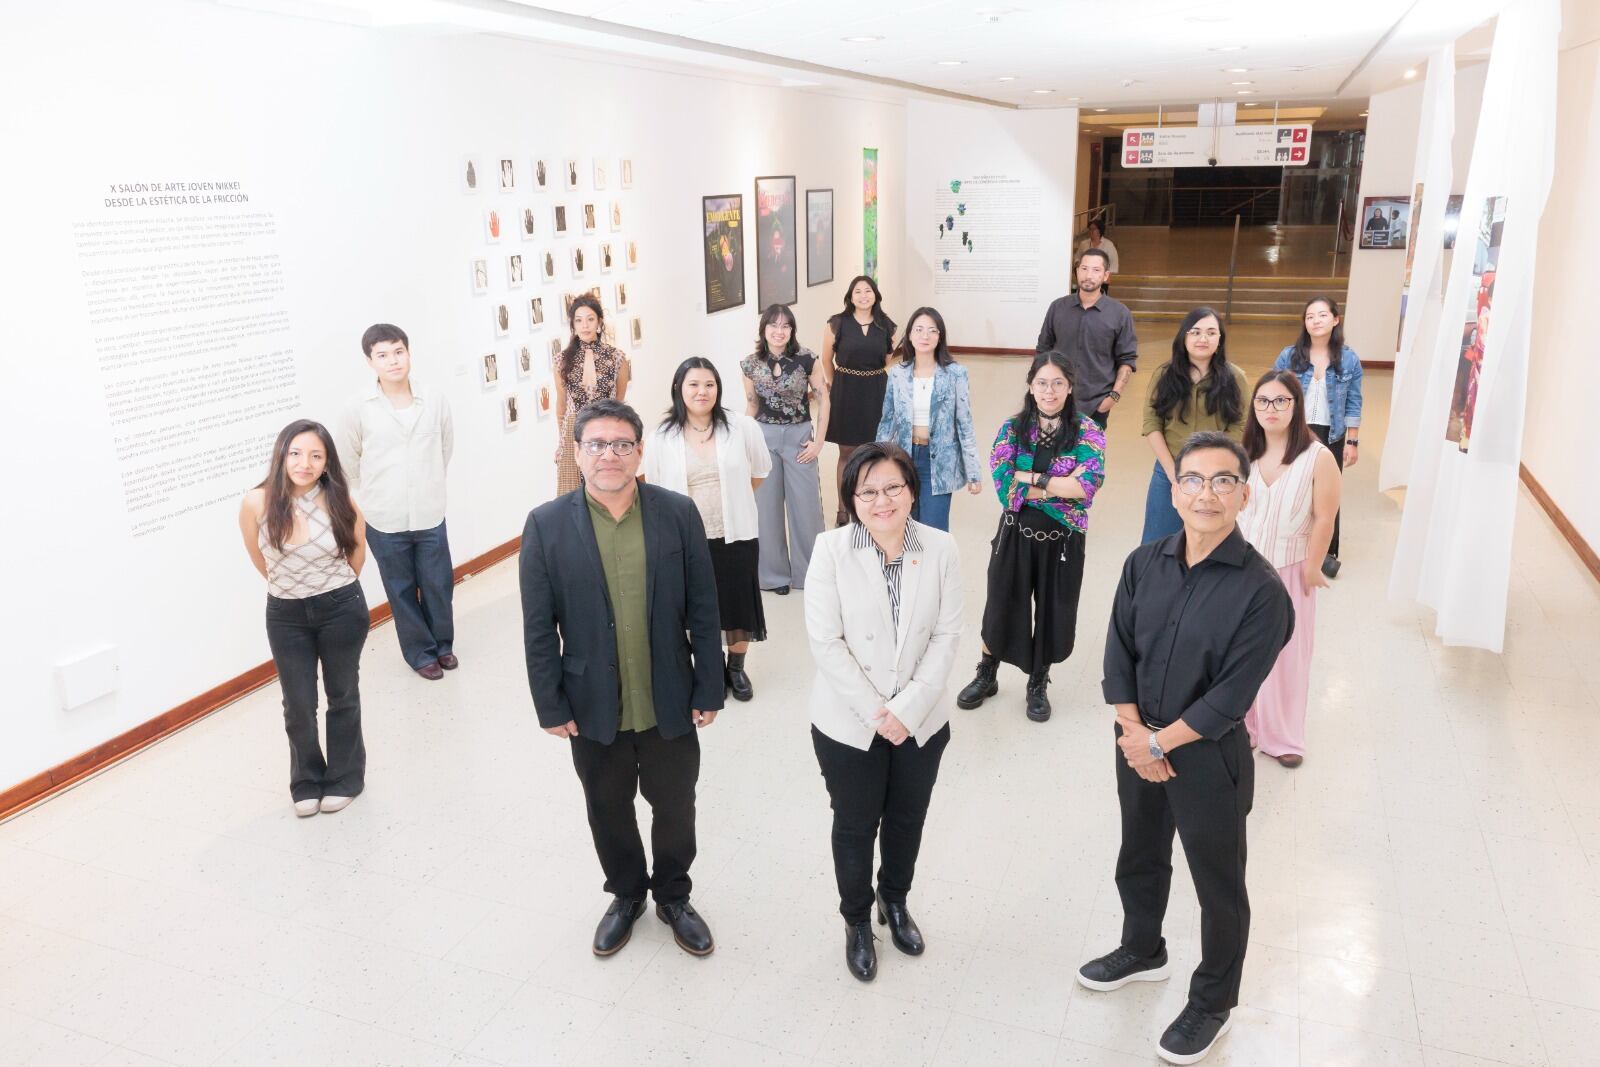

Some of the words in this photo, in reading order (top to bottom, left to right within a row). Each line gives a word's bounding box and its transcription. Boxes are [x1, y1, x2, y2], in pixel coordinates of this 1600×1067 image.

[118, 182, 148, 193] SALÓN
[151, 183, 163, 192] DE
[165, 183, 186, 192] ARTE
[188, 182, 214, 192] JOVEN
[216, 182, 240, 191] NIKKEI
[105, 197, 134, 208] DESDE
[136, 197, 148, 207] LA
[149, 194, 187, 206] ESTÉTICA
[190, 196, 200, 205] DE
[202, 195, 212, 204] LA
[214, 193, 249, 204] FRICCIÓN
